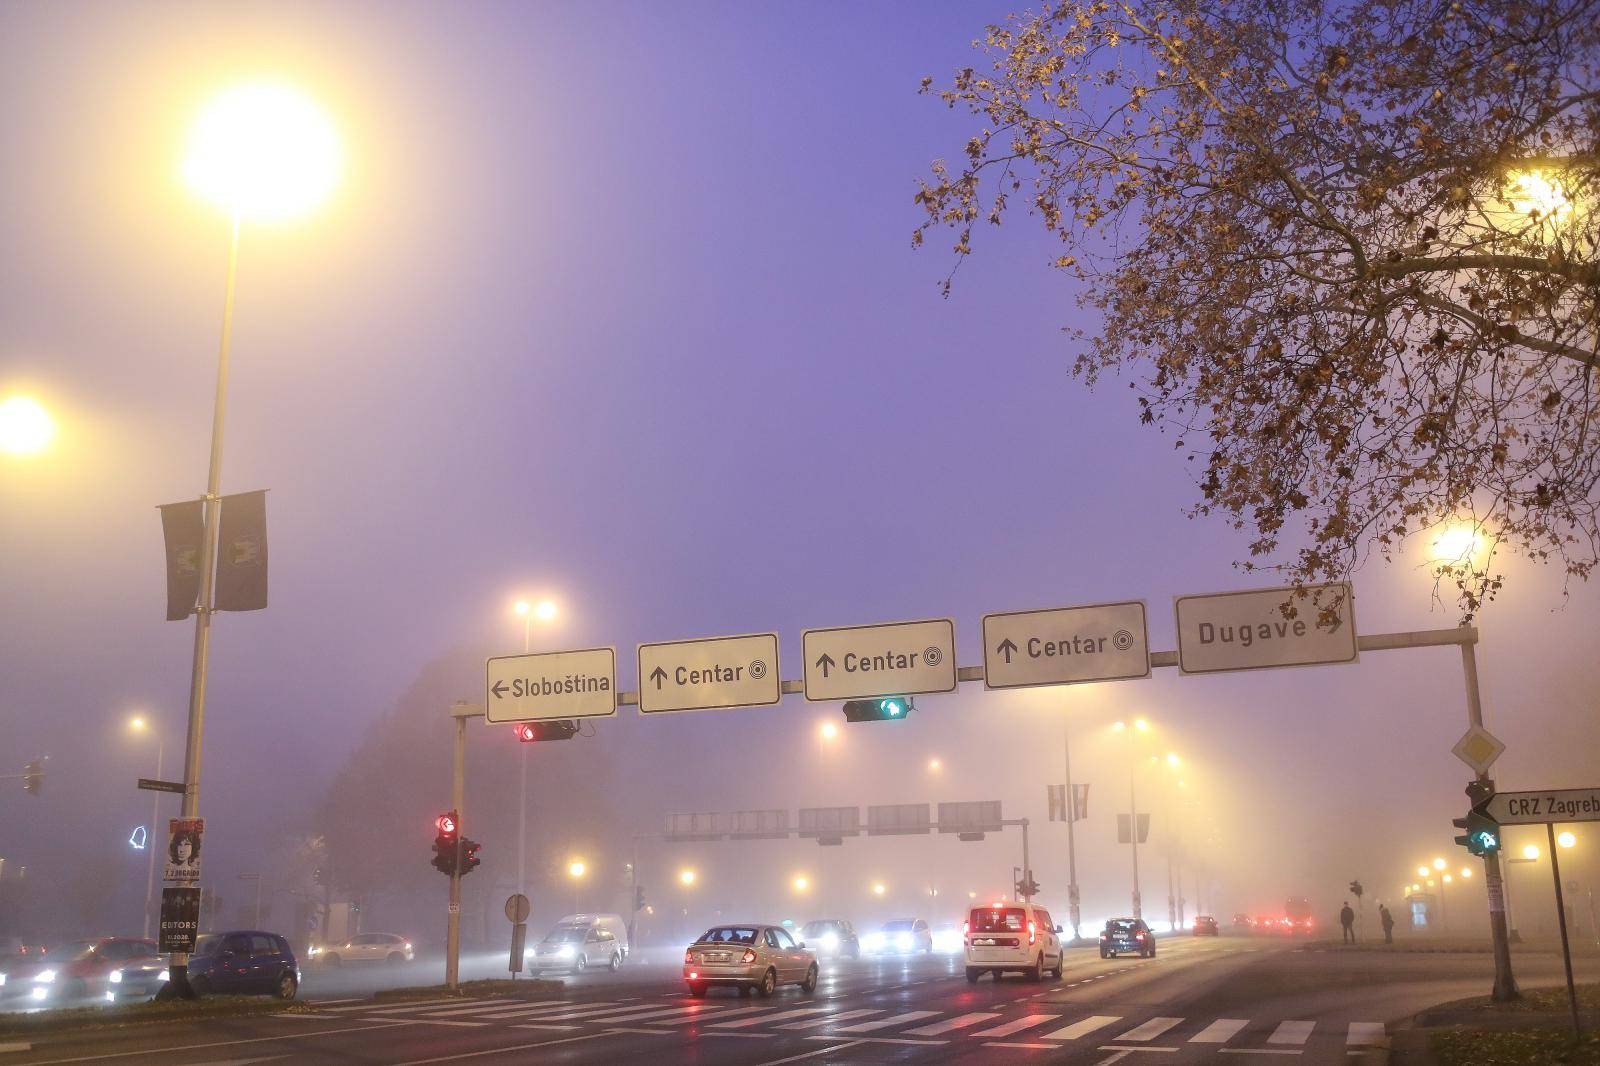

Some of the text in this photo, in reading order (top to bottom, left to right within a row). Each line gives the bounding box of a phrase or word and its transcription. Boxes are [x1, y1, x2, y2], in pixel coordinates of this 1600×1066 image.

[1199, 619, 1306, 647] Dugave
[1027, 635, 1107, 659] Centar
[843, 649, 918, 673] Centar
[512, 672, 610, 698] Sloboština
[675, 663, 744, 686] Centar
[1508, 796, 1600, 817] CRZ Zagreb
[161, 921, 197, 929] EDITORS
